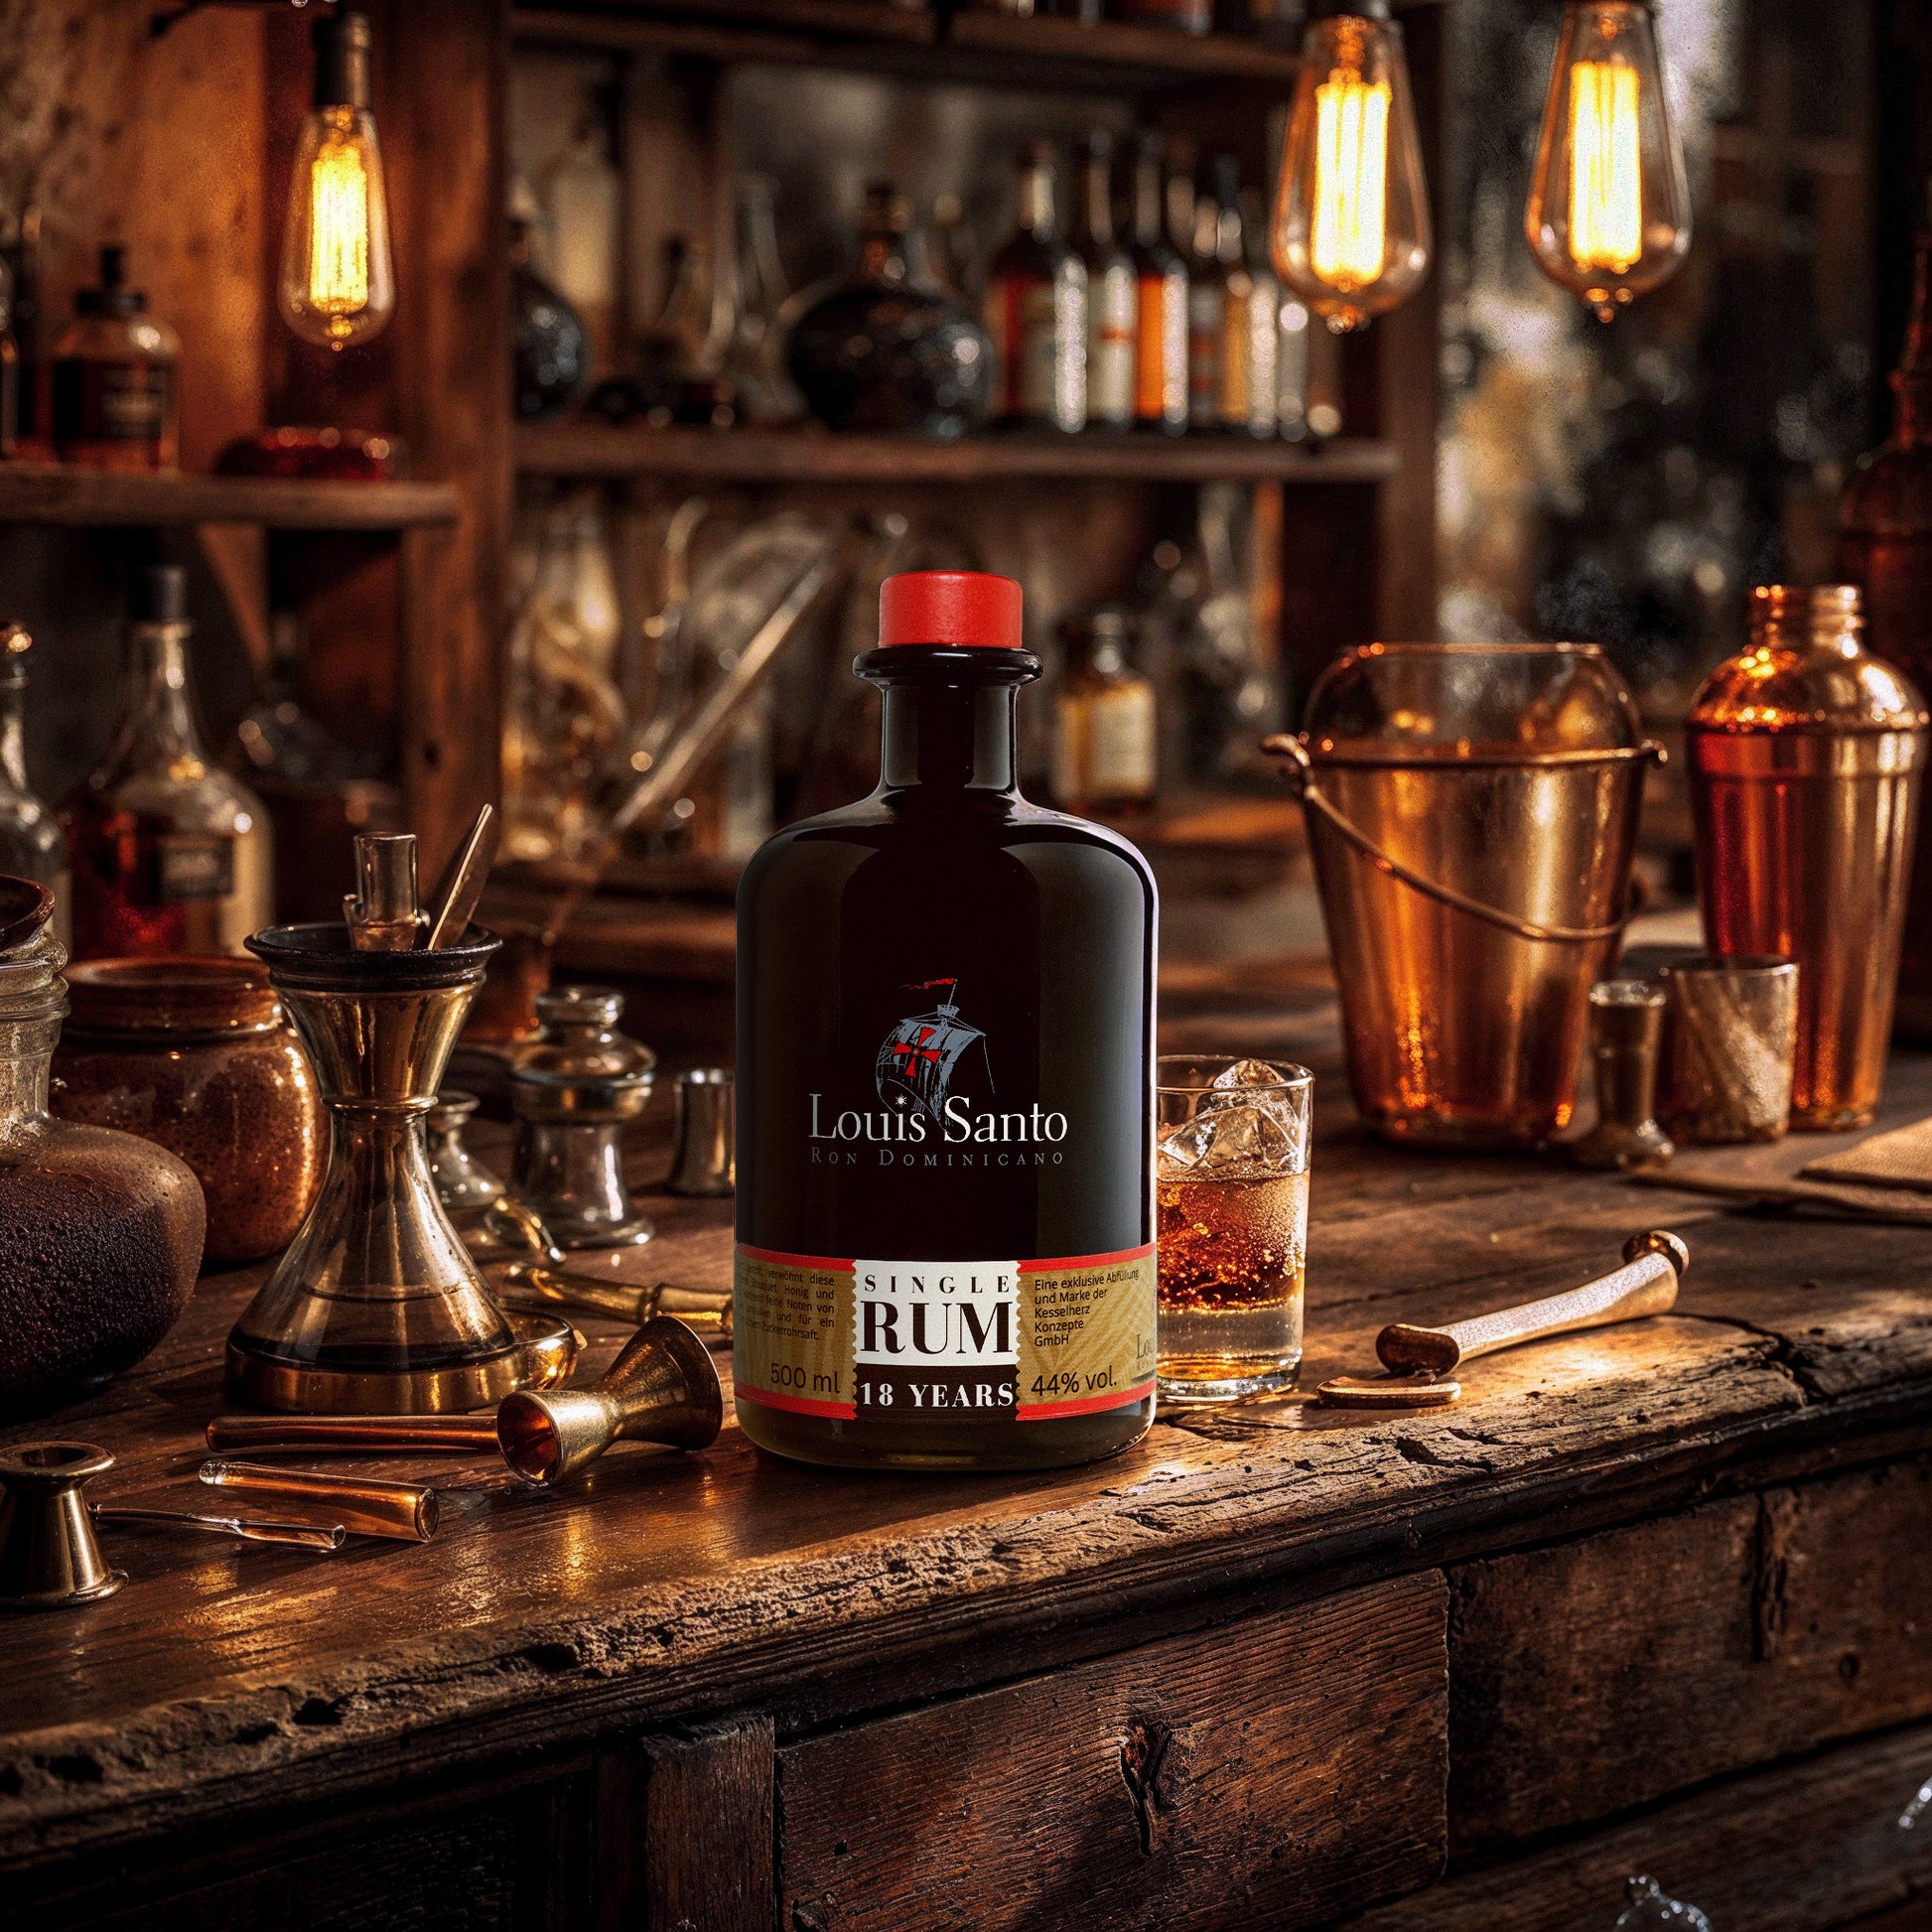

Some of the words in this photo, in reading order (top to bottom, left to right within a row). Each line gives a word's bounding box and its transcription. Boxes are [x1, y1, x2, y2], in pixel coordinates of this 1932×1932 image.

[809, 1093, 926, 1143] Louis
[944, 1095, 1068, 1143] Santo
[809, 1274, 835, 1286] diese
[864, 1274, 1010, 1294] SINGLE
[1035, 1279, 1058, 1291] Eine
[1060, 1276, 1105, 1289] exklusive
[784, 1285, 809, 1300] Honig
[816, 1290, 835, 1300] und
[1035, 1292, 1056, 1305] und
[1059, 1291, 1091, 1303] Marke
[1093, 1288, 1108, 1300] der
[786, 1299, 813, 1311] Noten
[817, 1304, 835, 1313] von
[1035, 1305, 1090, 1318] Kesselherz
[776, 1312, 791, 1322] und
[798, 1312, 812, 1325] für
[819, 1316, 835, 1328] ein
[860, 1301, 1013, 1354] RUM
[1035, 1319, 1084, 1333] Konzepte
[1035, 1334, 1069, 1347] GmbH
[770, 1362, 806, 1389] 500
[814, 1371, 840, 1394] ml
[1031, 1371, 1080, 1397] 44%
[1085, 1365, 1118, 1391] vol.
[860, 1382, 894, 1407] 18
[908, 1382, 1014, 1408] YEARS
